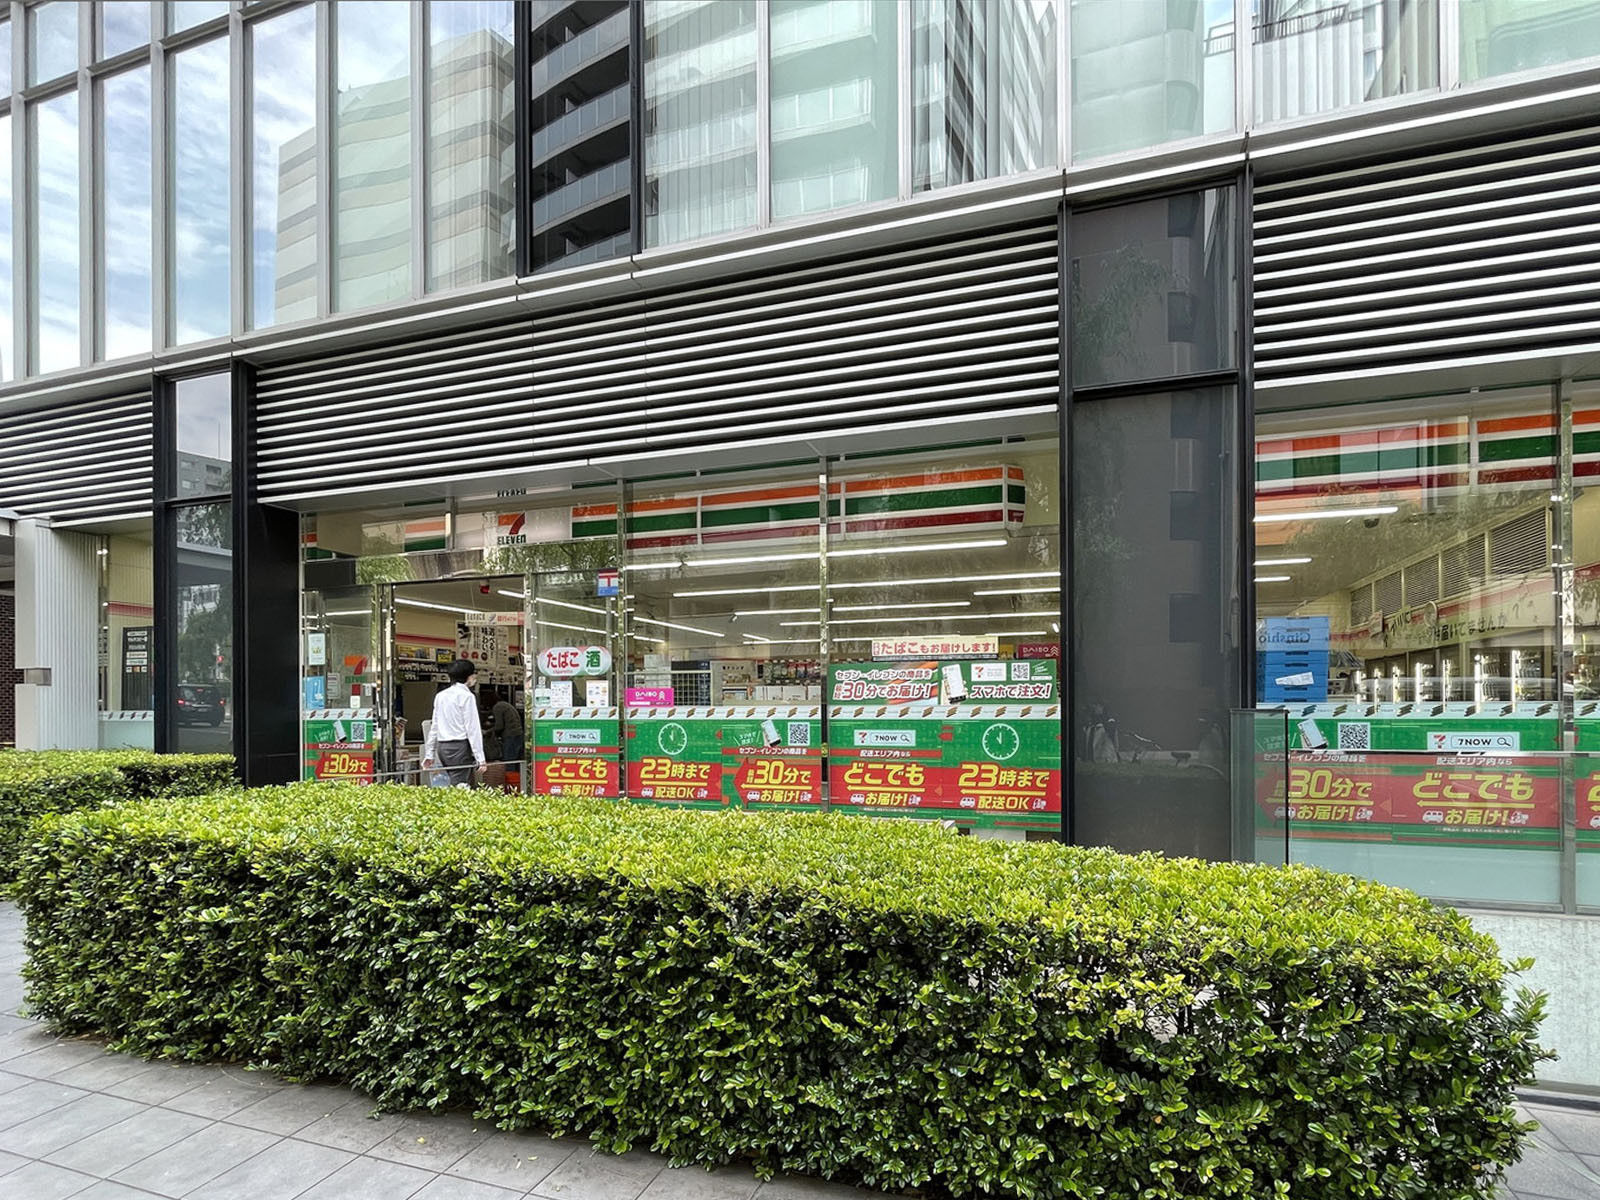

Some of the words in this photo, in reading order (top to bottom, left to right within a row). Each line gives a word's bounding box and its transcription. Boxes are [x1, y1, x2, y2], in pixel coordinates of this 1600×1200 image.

[547, 651, 580, 668] たばこ
[586, 650, 601, 668] 酒
[971, 684, 1051, 697] スマホで注文!
[1458, 738, 1492, 746] 7NOW
[544, 758, 608, 779] どこでも
[639, 758, 711, 779] 23時まで
[843, 762, 925, 786] どこでも
[958, 763, 1050, 788] 23時まで
[655, 786, 695, 798] 配送OK
[1412, 772, 1535, 801] どこでも
[760, 789, 800, 803] お届け!
[865, 792, 908, 806] お届け!
[977, 795, 1030, 810] 配送OK
[1296, 805, 1356, 821] お届け!
[1444, 809, 1510, 825] お届け!
